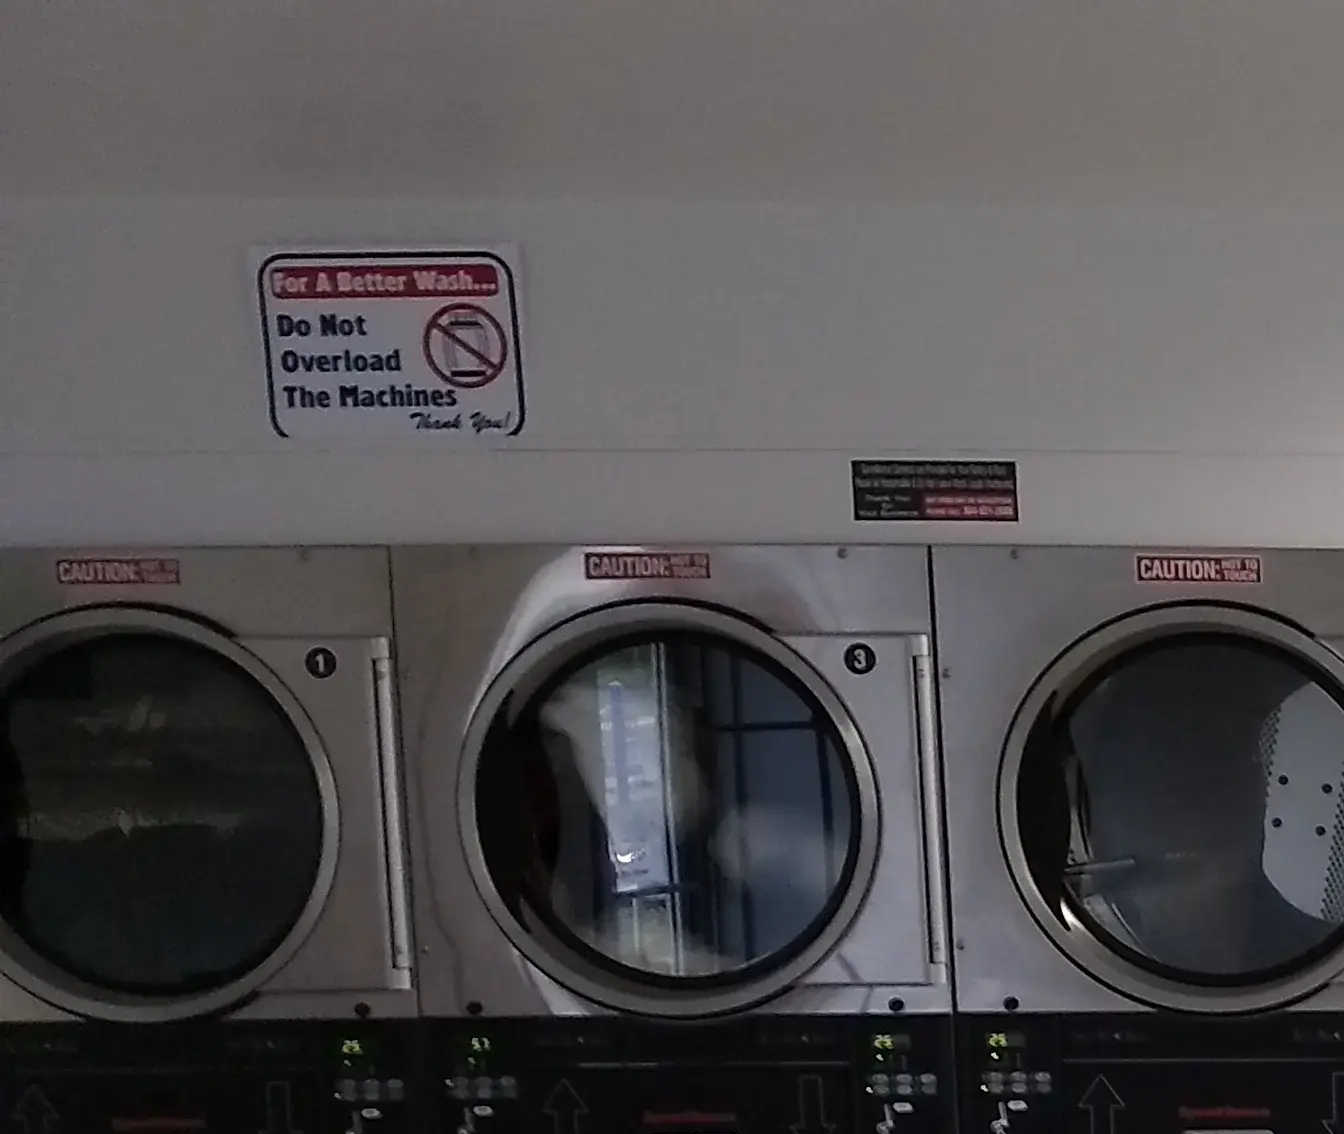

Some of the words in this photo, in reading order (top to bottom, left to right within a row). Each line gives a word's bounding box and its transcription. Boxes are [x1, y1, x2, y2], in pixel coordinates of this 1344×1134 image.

[272, 272, 308, 293] For
[316, 272, 331, 292] A
[337, 270, 407, 292] Better
[413, 270, 497, 291] Wash...
[276, 314, 310, 337] Do
[319, 314, 367, 336] Not
[280, 349, 401, 373] Overload
[283, 385, 330, 408] The
[339, 384, 457, 408] Machines
[409, 412, 463, 430] Thank
[469, 411, 511, 433] You!
[589, 556, 669, 576] CAUTION:
[1140, 559, 1220, 579] CAUTION:
[315, 654, 324, 673] 1
[854, 649, 866, 669] 3
